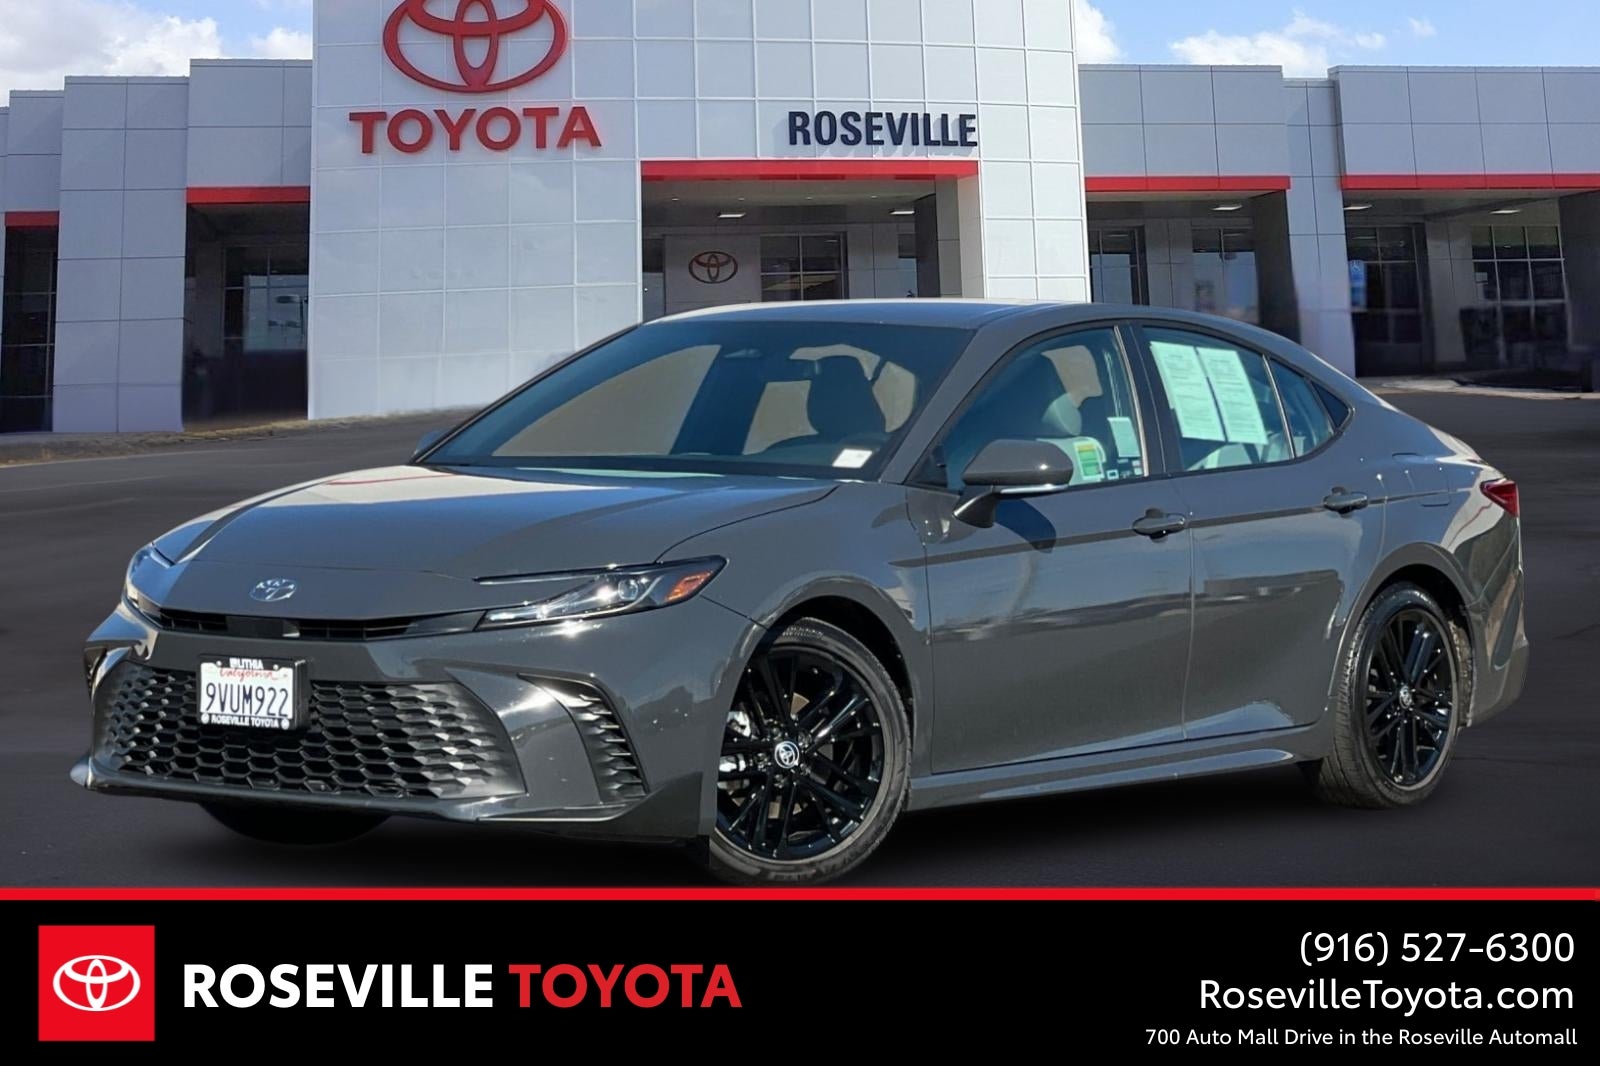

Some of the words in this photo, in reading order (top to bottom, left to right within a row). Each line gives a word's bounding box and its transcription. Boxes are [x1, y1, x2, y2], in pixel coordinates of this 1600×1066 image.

[350, 106, 602, 154] TOYOTA
[788, 110, 978, 147] ROSEVILLE
[219, 669, 278, 681] California
[206, 682, 288, 717] 9VUM922
[211, 714, 250, 726] ROSEVILLE
[251, 718, 279, 728] TOYOTA
